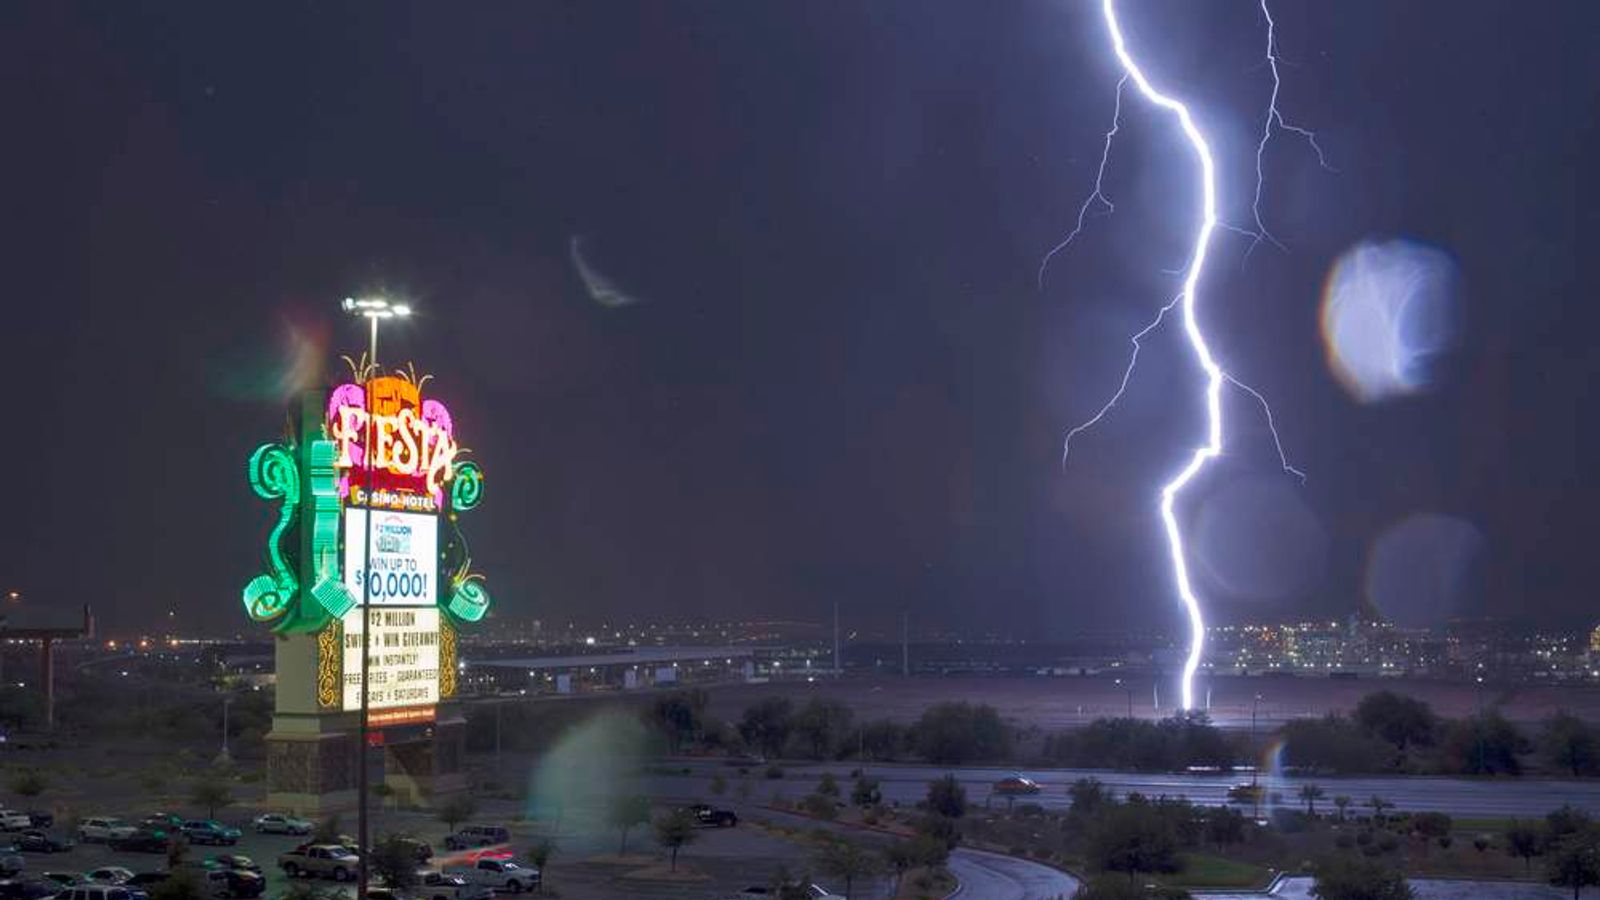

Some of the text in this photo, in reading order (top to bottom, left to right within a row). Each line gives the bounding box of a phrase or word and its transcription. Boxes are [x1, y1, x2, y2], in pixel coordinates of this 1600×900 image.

[333, 404, 457, 495] FIESTA
[357, 490, 436, 508] CSINO HOTEL
[390, 559, 403, 571] UP
[405, 559, 417, 571] TO
[355, 570, 427, 602] $0,000!
[371, 611, 415, 626] $2 MILLION
[346, 633, 371, 648] SWI
[403, 631, 440, 646] GIVEAWAY
[343, 673, 361, 684] FREE
[397, 669, 438, 681] GUARANTEED
[394, 687, 428, 700] SATURDAYS
